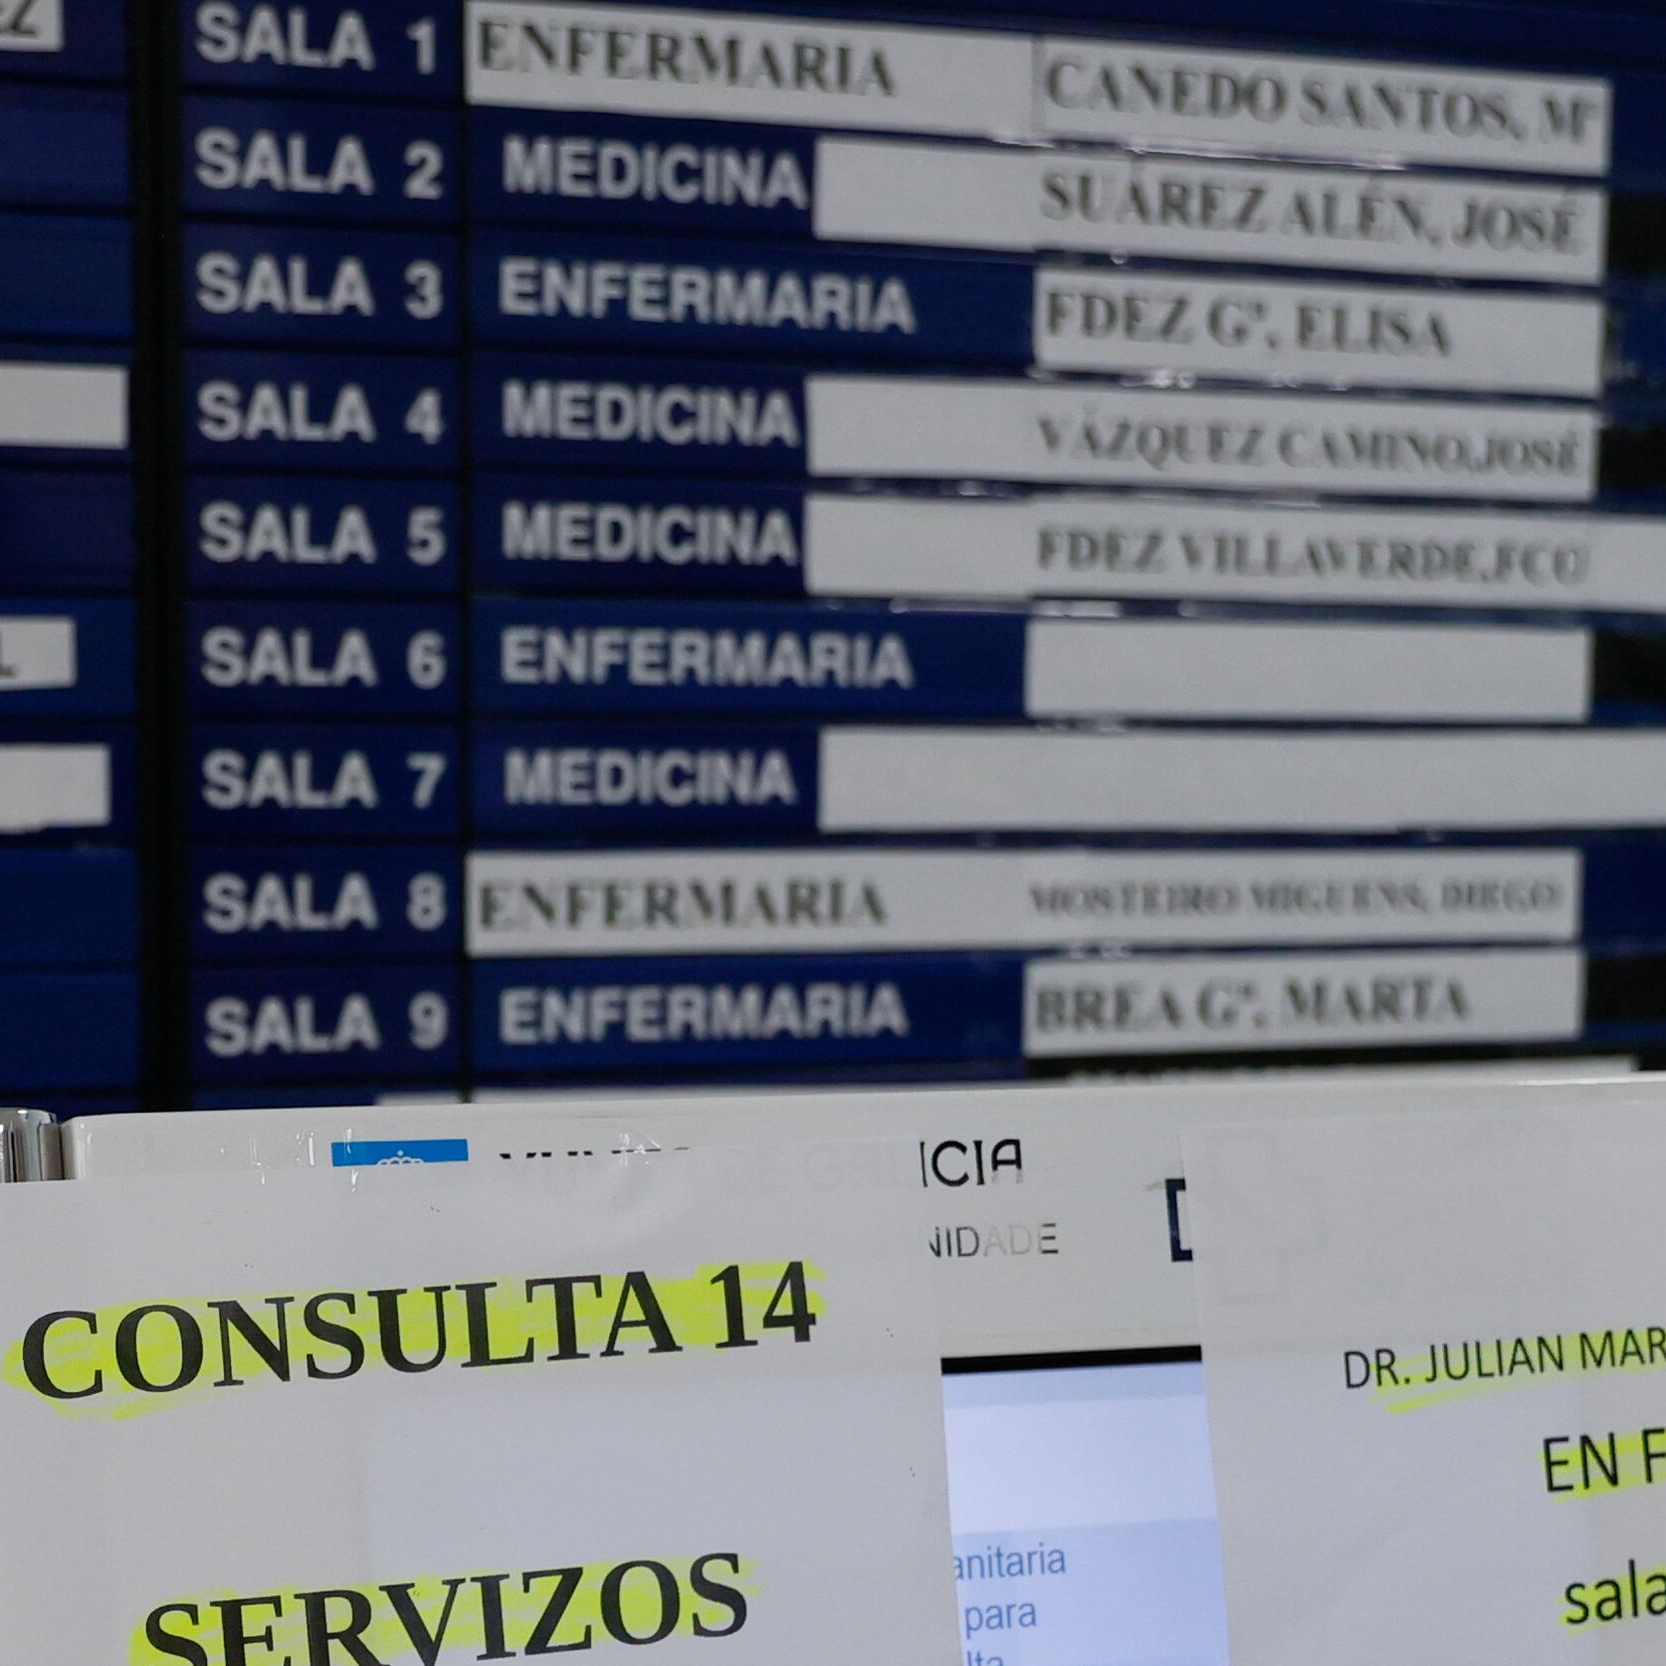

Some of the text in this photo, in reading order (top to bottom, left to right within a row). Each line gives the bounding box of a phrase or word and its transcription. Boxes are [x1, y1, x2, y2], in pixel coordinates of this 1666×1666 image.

[196, 3, 435, 75] SALA 1
[196, 129, 442, 200] SALA 2
[504, 136, 808, 210] MEDICINA
[196, 253, 442, 319] SALA 3
[499, 258, 916, 334] ENFERMARIA
[1297, 305, 1452, 358] ELISA
[198, 382, 442, 444] SALA 4
[502, 380, 799, 448] MEDICINA
[200, 503, 444, 565] SALA 5
[502, 501, 799, 567] MEDICINA
[201, 629, 444, 688] SALA 6
[501, 627, 913, 690] ENFERMARIA
[203, 751, 445, 809] SALA 7
[505, 750, 796, 804] MEDICINA
[204, 874, 445, 932] SALA 8
[206, 992, 447, 1055] SALA 9
[500, 984, 908, 1045] ENFERMARIA
[1285, 975, 1469, 1025] MARTA
[20, 1260, 817, 1401] CONSULTA 14
[1343, 1343, 1412, 1390] DR.
[1425, 1334, 1565, 1385] JULIAN
[1544, 1434, 1618, 1493] EN
[965, 1602, 1037, 1639] para
